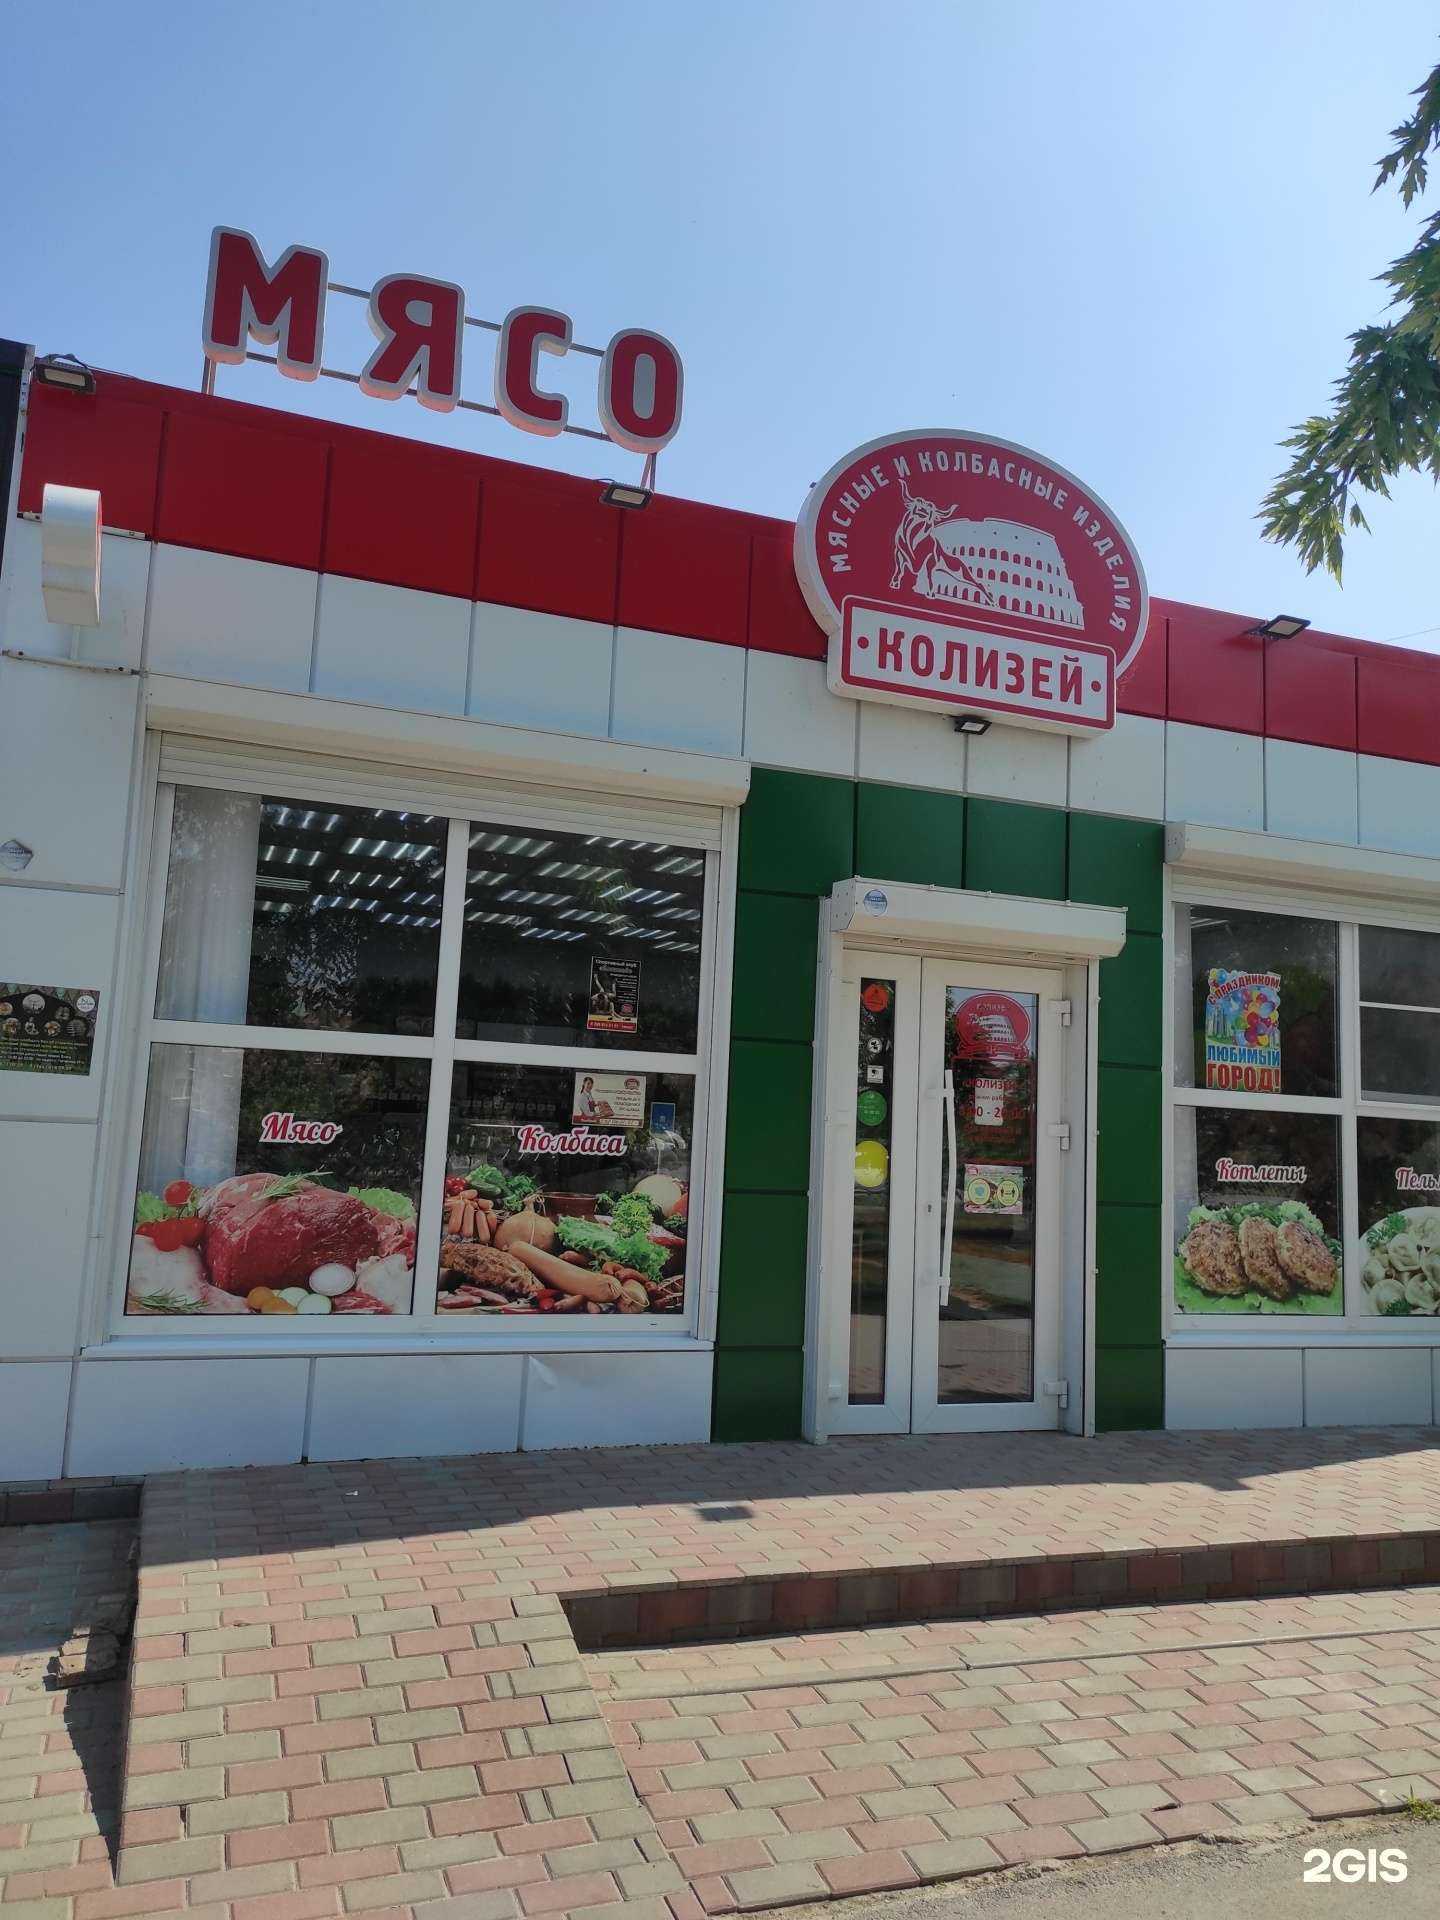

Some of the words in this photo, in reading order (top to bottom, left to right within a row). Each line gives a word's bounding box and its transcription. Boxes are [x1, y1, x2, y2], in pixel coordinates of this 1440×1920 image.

[203, 226, 684, 454] МЯСО
[828, 465, 889, 573] МЯСНЫЕ
[893, 456, 911, 478] И
[918, 450, 1068, 510] КОЛБАСНЫЕ
[1072, 505, 1132, 632] ИЗДЕЛИЯ
[877, 627, 1084, 706] КОЛИЗЕЙ
[1208, 1045, 1280, 1067] ЛЮБИМЫЙ
[1207, 1063, 1280, 1092] ГОРОД!
[259, 1112, 343, 1144] Мясо
[518, 1125, 627, 1156] Колбаса
[1216, 1158, 1307, 1183] Котлеты
[1395, 1167, 1440, 1190] Пель
